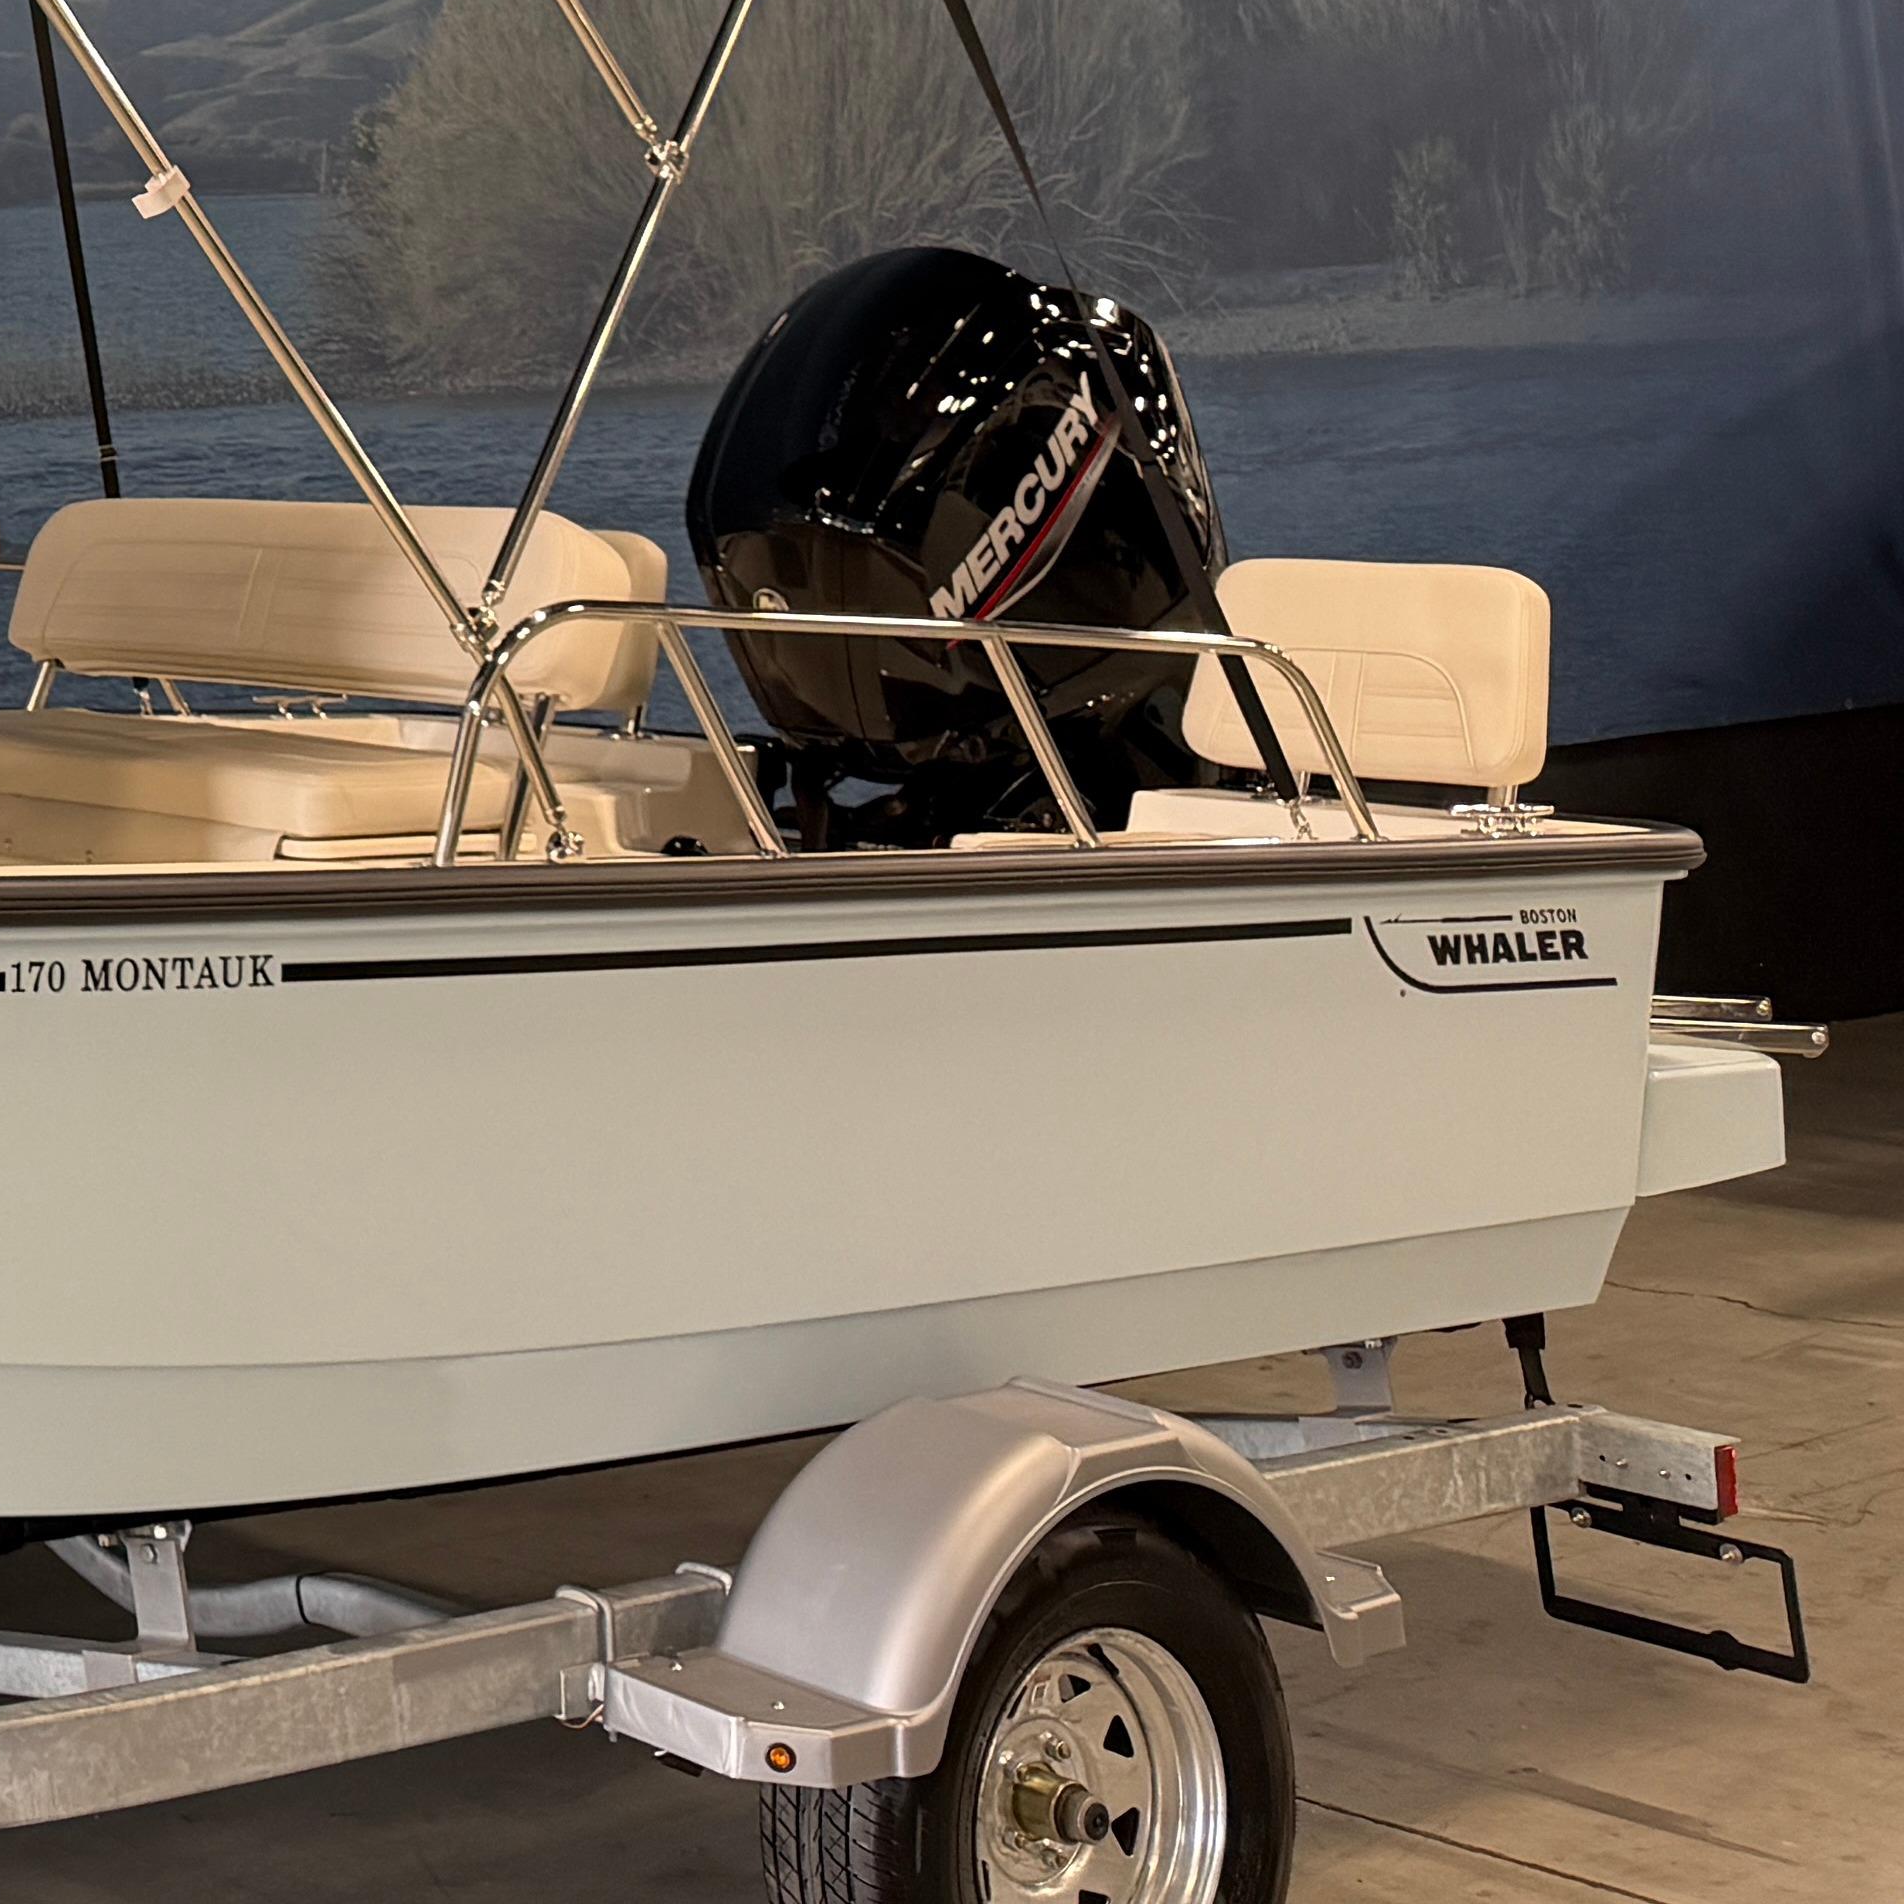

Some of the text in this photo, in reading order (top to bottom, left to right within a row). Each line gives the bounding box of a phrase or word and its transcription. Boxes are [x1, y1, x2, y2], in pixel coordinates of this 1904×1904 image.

[929, 370, 1099, 619] MERCURY
[1519, 908, 1578, 925] BOSTON
[1426, 929, 1589, 966] WHALER
[10, 954, 275, 993] 170 MONTAUK
